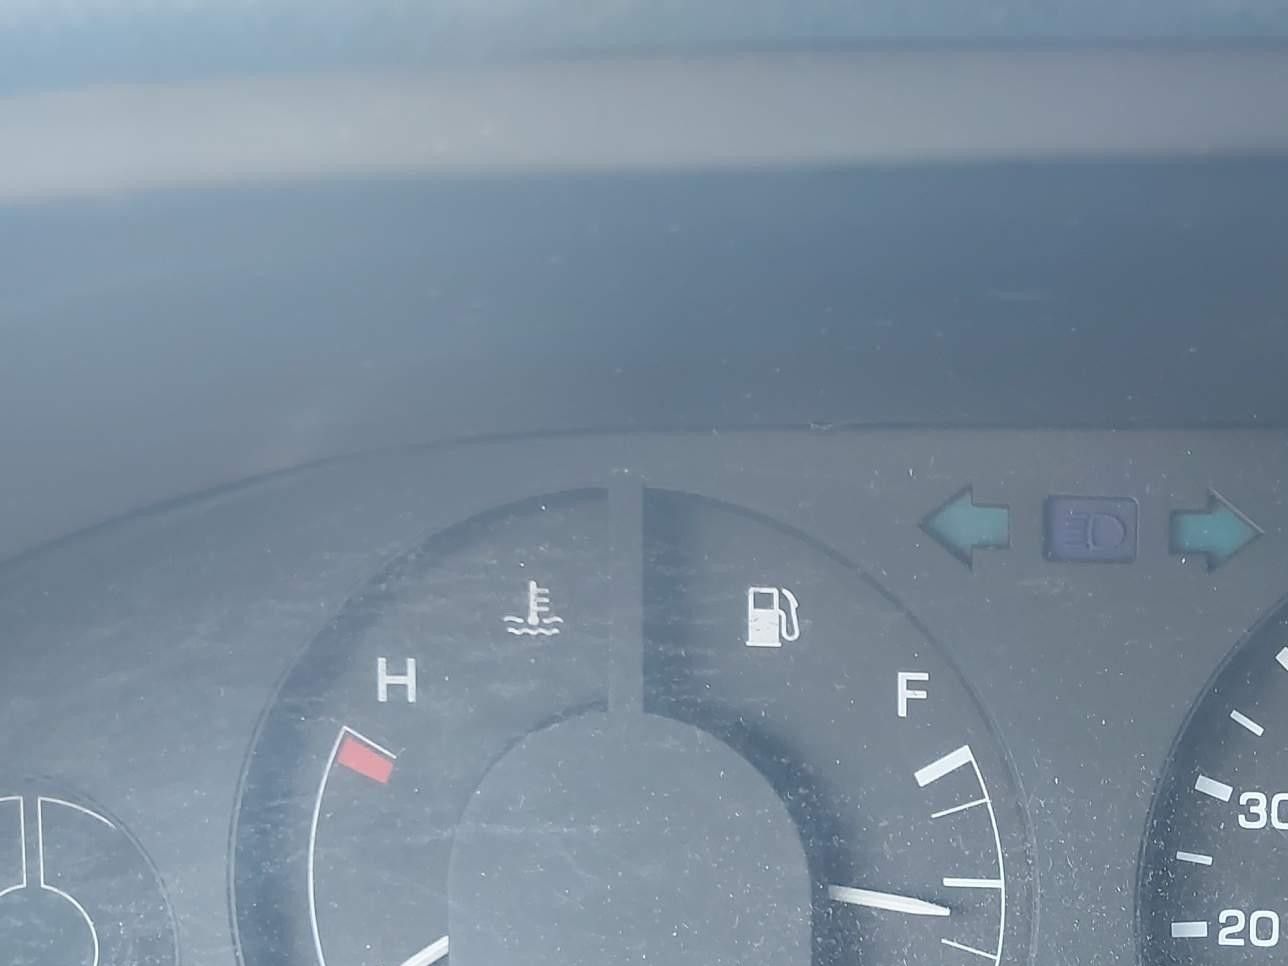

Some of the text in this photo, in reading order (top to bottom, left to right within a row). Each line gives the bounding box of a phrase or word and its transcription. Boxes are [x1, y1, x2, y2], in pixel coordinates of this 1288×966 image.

[376, 657, 418, 703] H
[897, 671, 930, 717] F
[1218, 909, 1280, 947] 20
